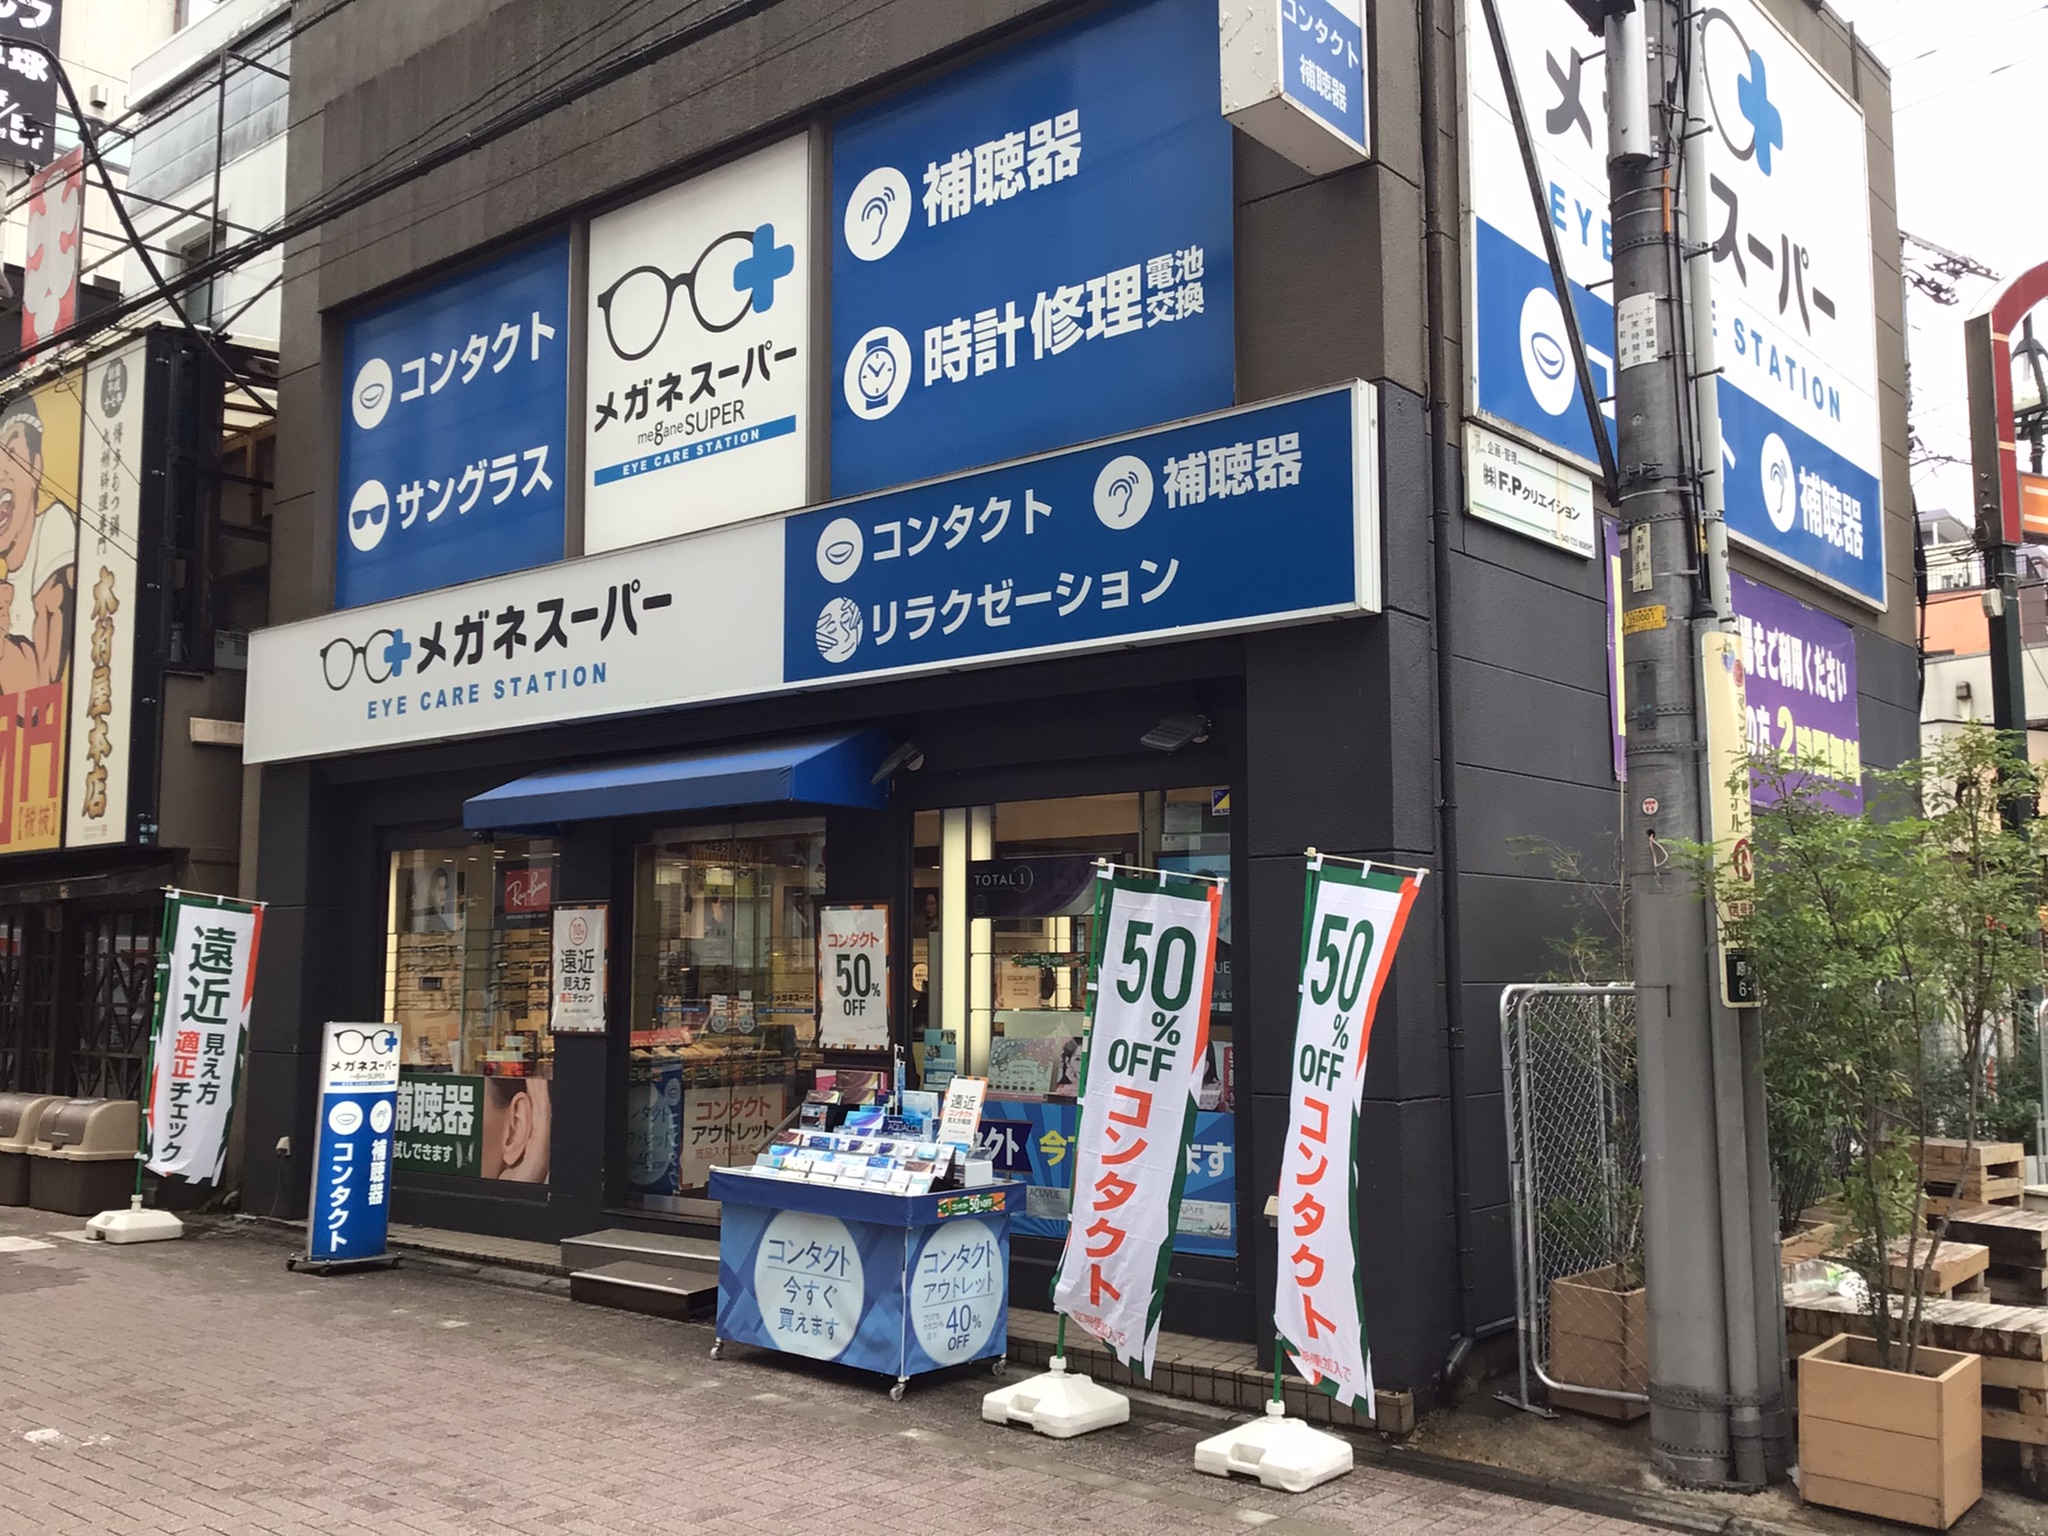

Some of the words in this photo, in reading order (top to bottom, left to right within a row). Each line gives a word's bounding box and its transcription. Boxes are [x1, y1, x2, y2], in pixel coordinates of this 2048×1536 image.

[1283, 0, 1359, 69] コンタクト
[1299, 53, 1348, 113] 補聴器
[922, 108, 1082, 228] 補聴器
[1145, 244, 1204, 293] 電池
[923, 263, 1144, 387] 時計修理
[1145, 281, 1204, 329] 交換
[400, 311, 556, 403] コンタクト
[1733, 316, 1841, 423] STATION
[594, 339, 798, 434] メガネスーパー
[637, 399, 745, 446] meganeSUPER
[622, 459, 647, 476] EYE
[654, 447, 690, 467] CARE
[696, 428, 760, 457] STATION
[1163, 431, 1303, 509] 補聴器
[395, 445, 554, 530] サングラス
[873, 488, 1053, 562] コンタクト
[1798, 465, 1865, 561] 補聴器
[416, 578, 673, 674] メガネスーパー
[872, 558, 1180, 646] リラクゼーション
[366, 695, 407, 720] EYE
[420, 683, 480, 713] CARE
[493, 662, 608, 700] STATION
[506, 870, 549, 907] Ray-Ban
[974, 873, 1015, 887] TOTAL
[560, 948, 595, 974] 遠近
[827, 931, 880, 949] コンタクト
[1310, 913, 1375, 1013] 50
[181, 925, 237, 1026] 遠近
[562, 976, 592, 991] 見え方
[835, 953, 881, 998] 50%
[1116, 919, 1197, 1012] 50
[559, 992, 595, 1003] 適正チェック
[843, 999, 866, 1016] OFF
[1151, 1010, 1181, 1046] %
[1332, 1013, 1350, 1050] %
[196, 1033, 225, 1106] 見え方
[330, 1060, 397, 1072] メガネスーパー
[1107, 1038, 1176, 1082] OFF
[1299, 1044, 1344, 1092] OFF
[159, 1030, 201, 1163] 適正チェック
[394, 1081, 474, 1136] 補聴器
[696, 1095, 771, 1121] コンタクト
[949, 1094, 977, 1111] 遠近
[691, 1119, 775, 1146] アウトレット
[1039, 1129, 1075, 1167] 今
[368, 1138, 388, 1206] 補聴器
[1084, 1085, 1153, 1307] コンタクト
[327, 1142, 354, 1253] コンタクト
[1290, 1095, 1337, 1340] コンタクト
[767, 1238, 851, 1277] コンタクト
[923, 1239, 995, 1274] コンタクト
[782, 1277, 838, 1307] 今すぐ
[923, 1270, 994, 1303] アウトレット
[777, 1307, 840, 1341] 買えます
[945, 1304, 982, 1334] 40%
[947, 1333, 970, 1351] OFF
